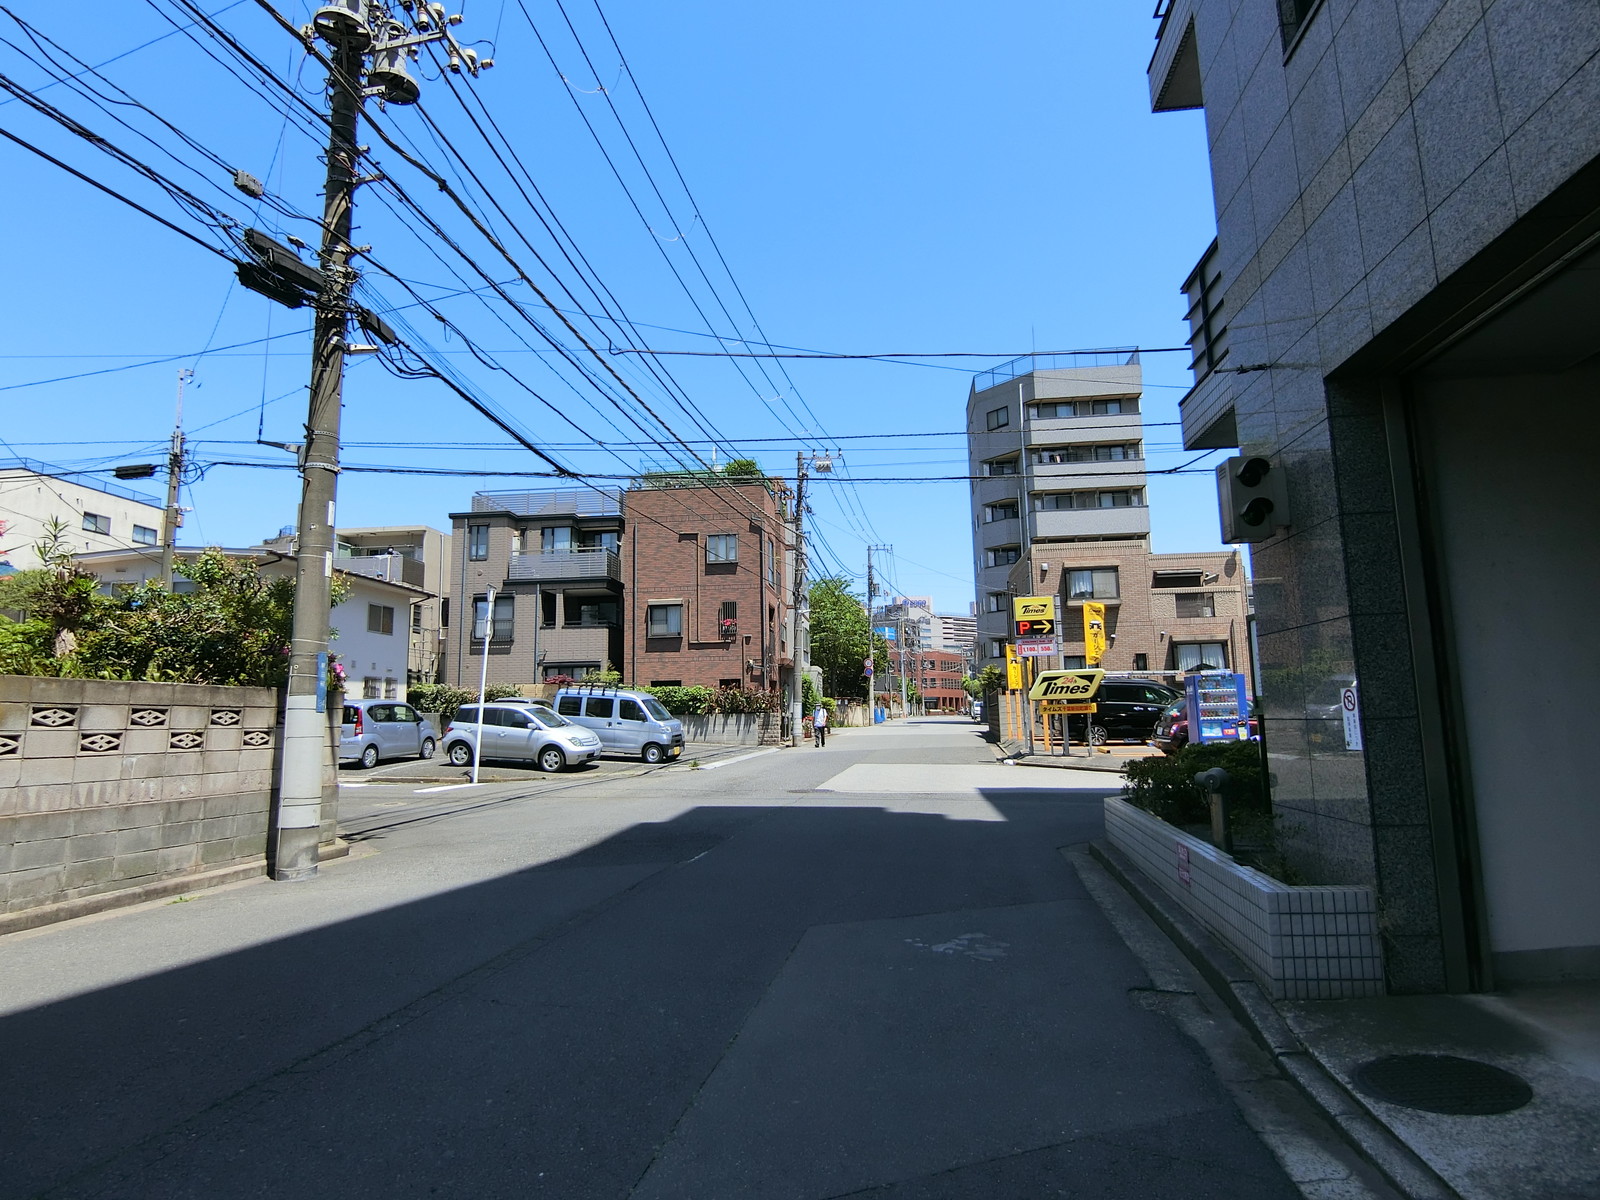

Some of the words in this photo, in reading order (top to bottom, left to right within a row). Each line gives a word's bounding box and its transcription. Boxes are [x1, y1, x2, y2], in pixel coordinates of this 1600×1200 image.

[1021, 606, 1045, 614] Times
[1019, 621, 1031, 634] P
[1040, 680, 1092, 696] Times
